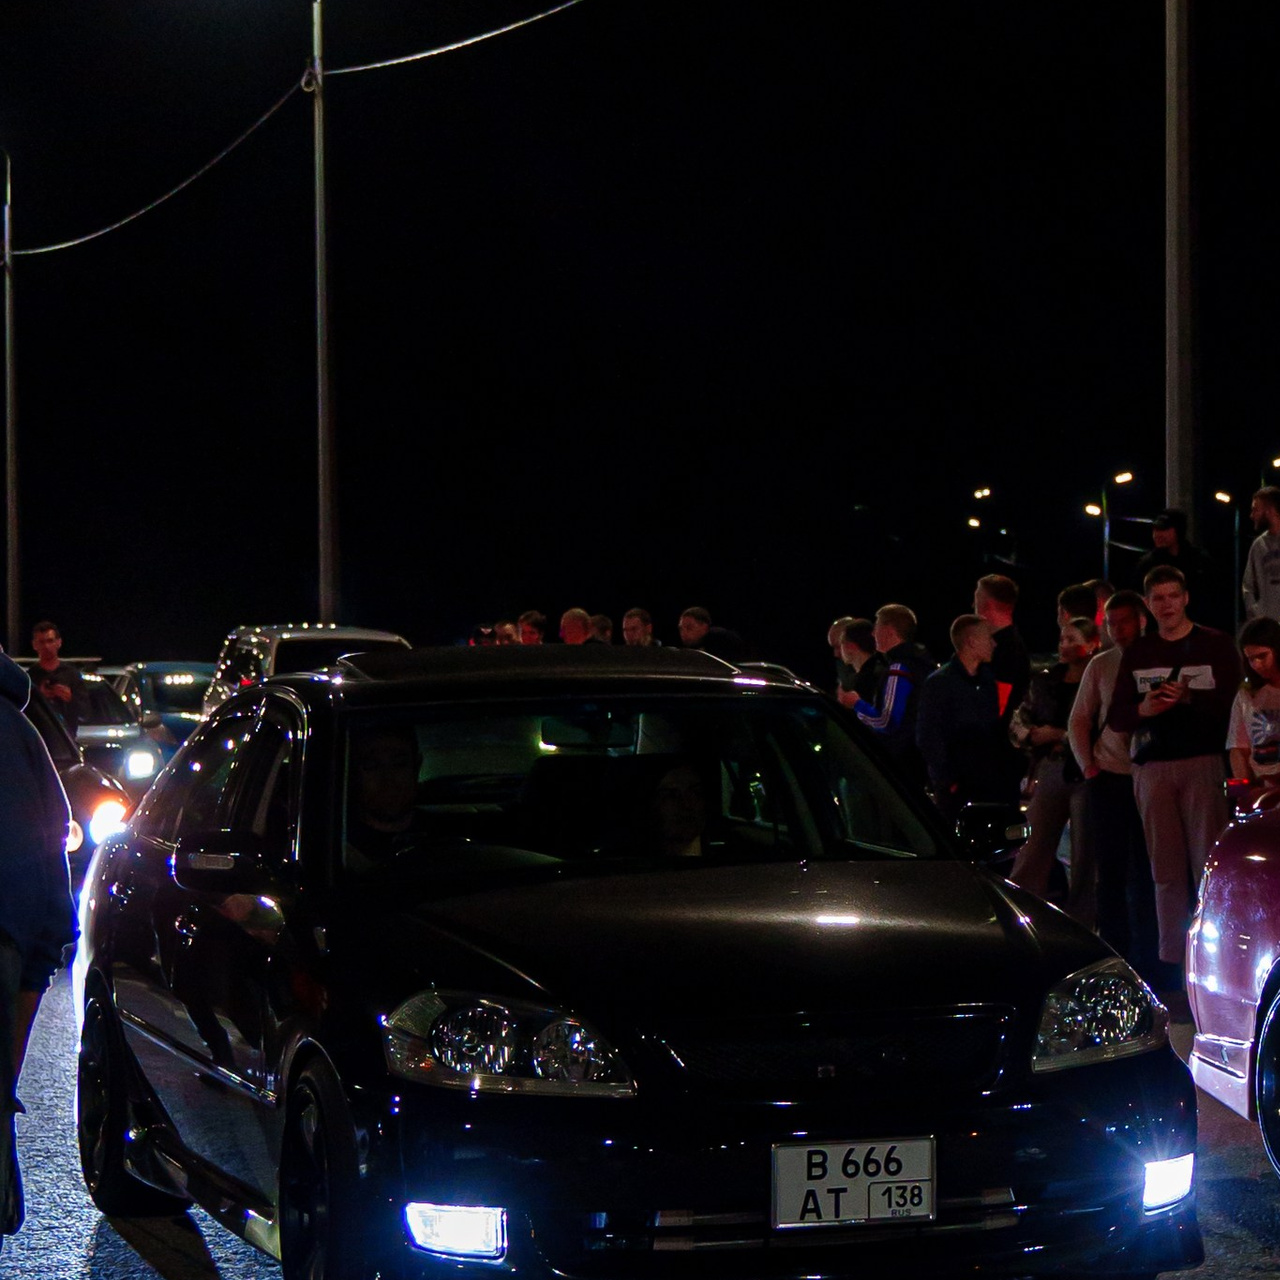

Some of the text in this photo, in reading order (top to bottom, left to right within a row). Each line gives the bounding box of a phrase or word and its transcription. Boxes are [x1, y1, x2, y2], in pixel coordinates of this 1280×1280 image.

[842, 1146, 903, 1178] 666
[881, 1185, 923, 1209] 138
[891, 1208, 911, 1217] RUS
